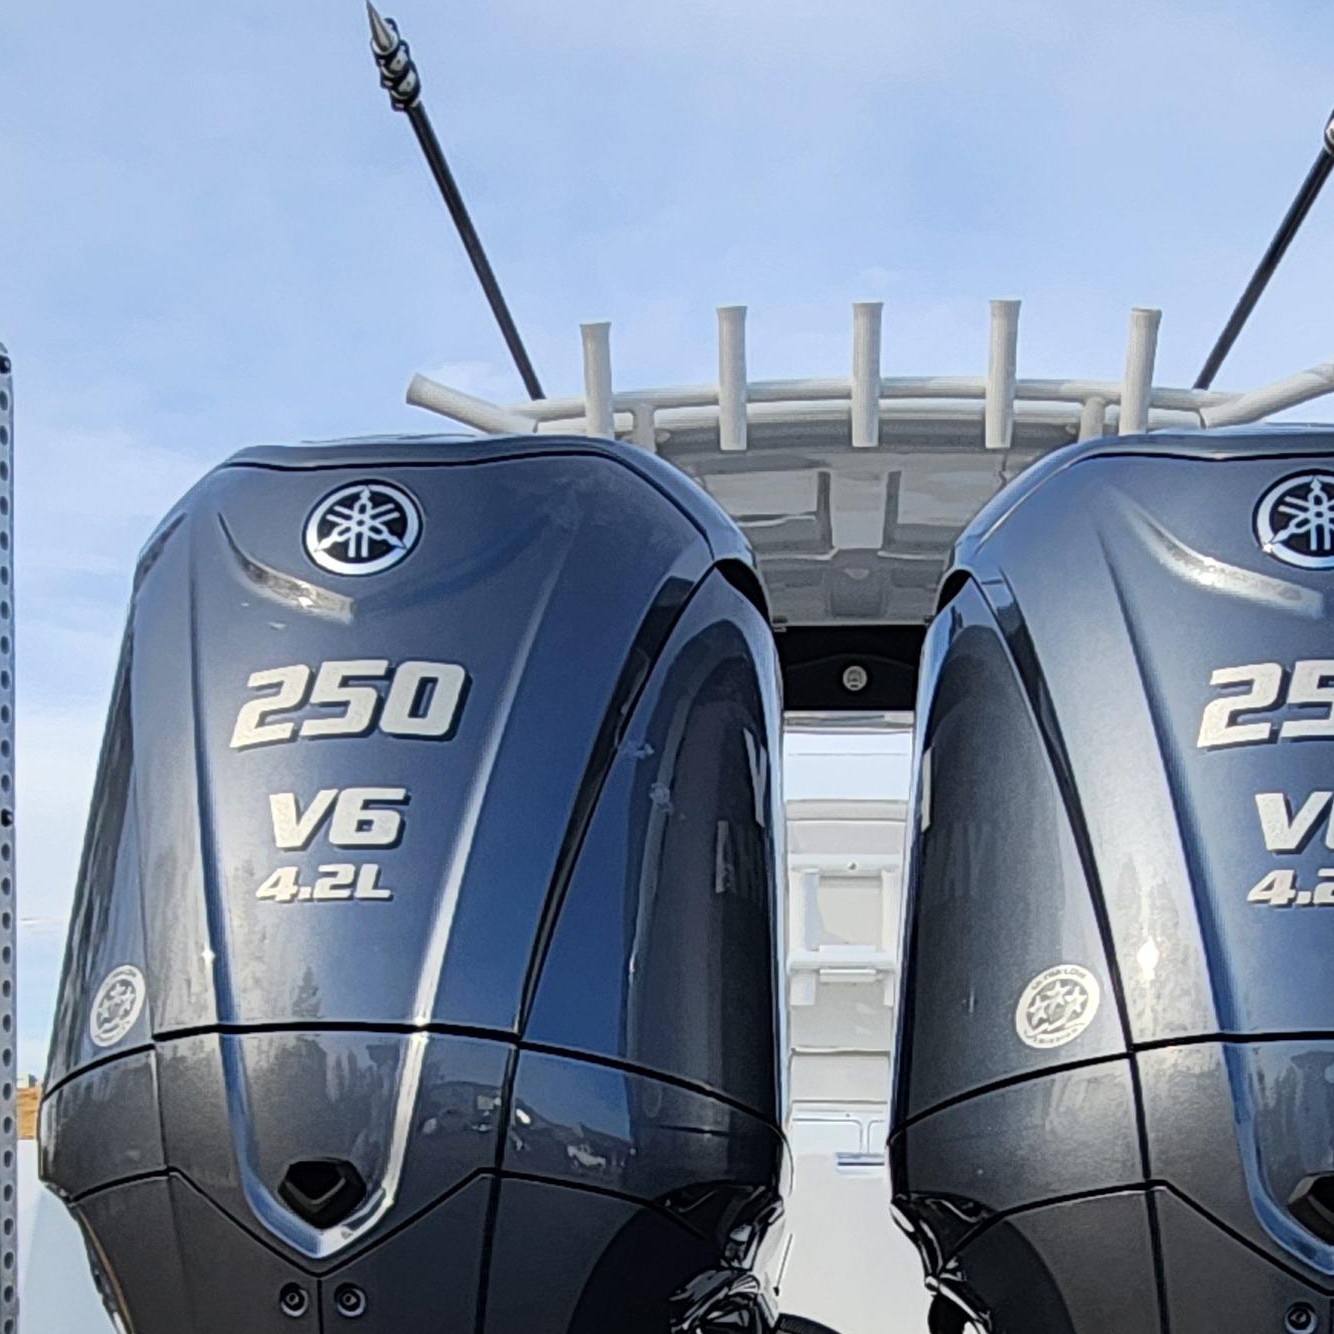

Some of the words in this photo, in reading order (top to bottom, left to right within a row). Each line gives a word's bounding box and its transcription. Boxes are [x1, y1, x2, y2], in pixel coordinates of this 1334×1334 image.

[230, 659, 467, 748] 250
[269, 788, 406, 849] V6
[255, 864, 392, 900] 4.2L
